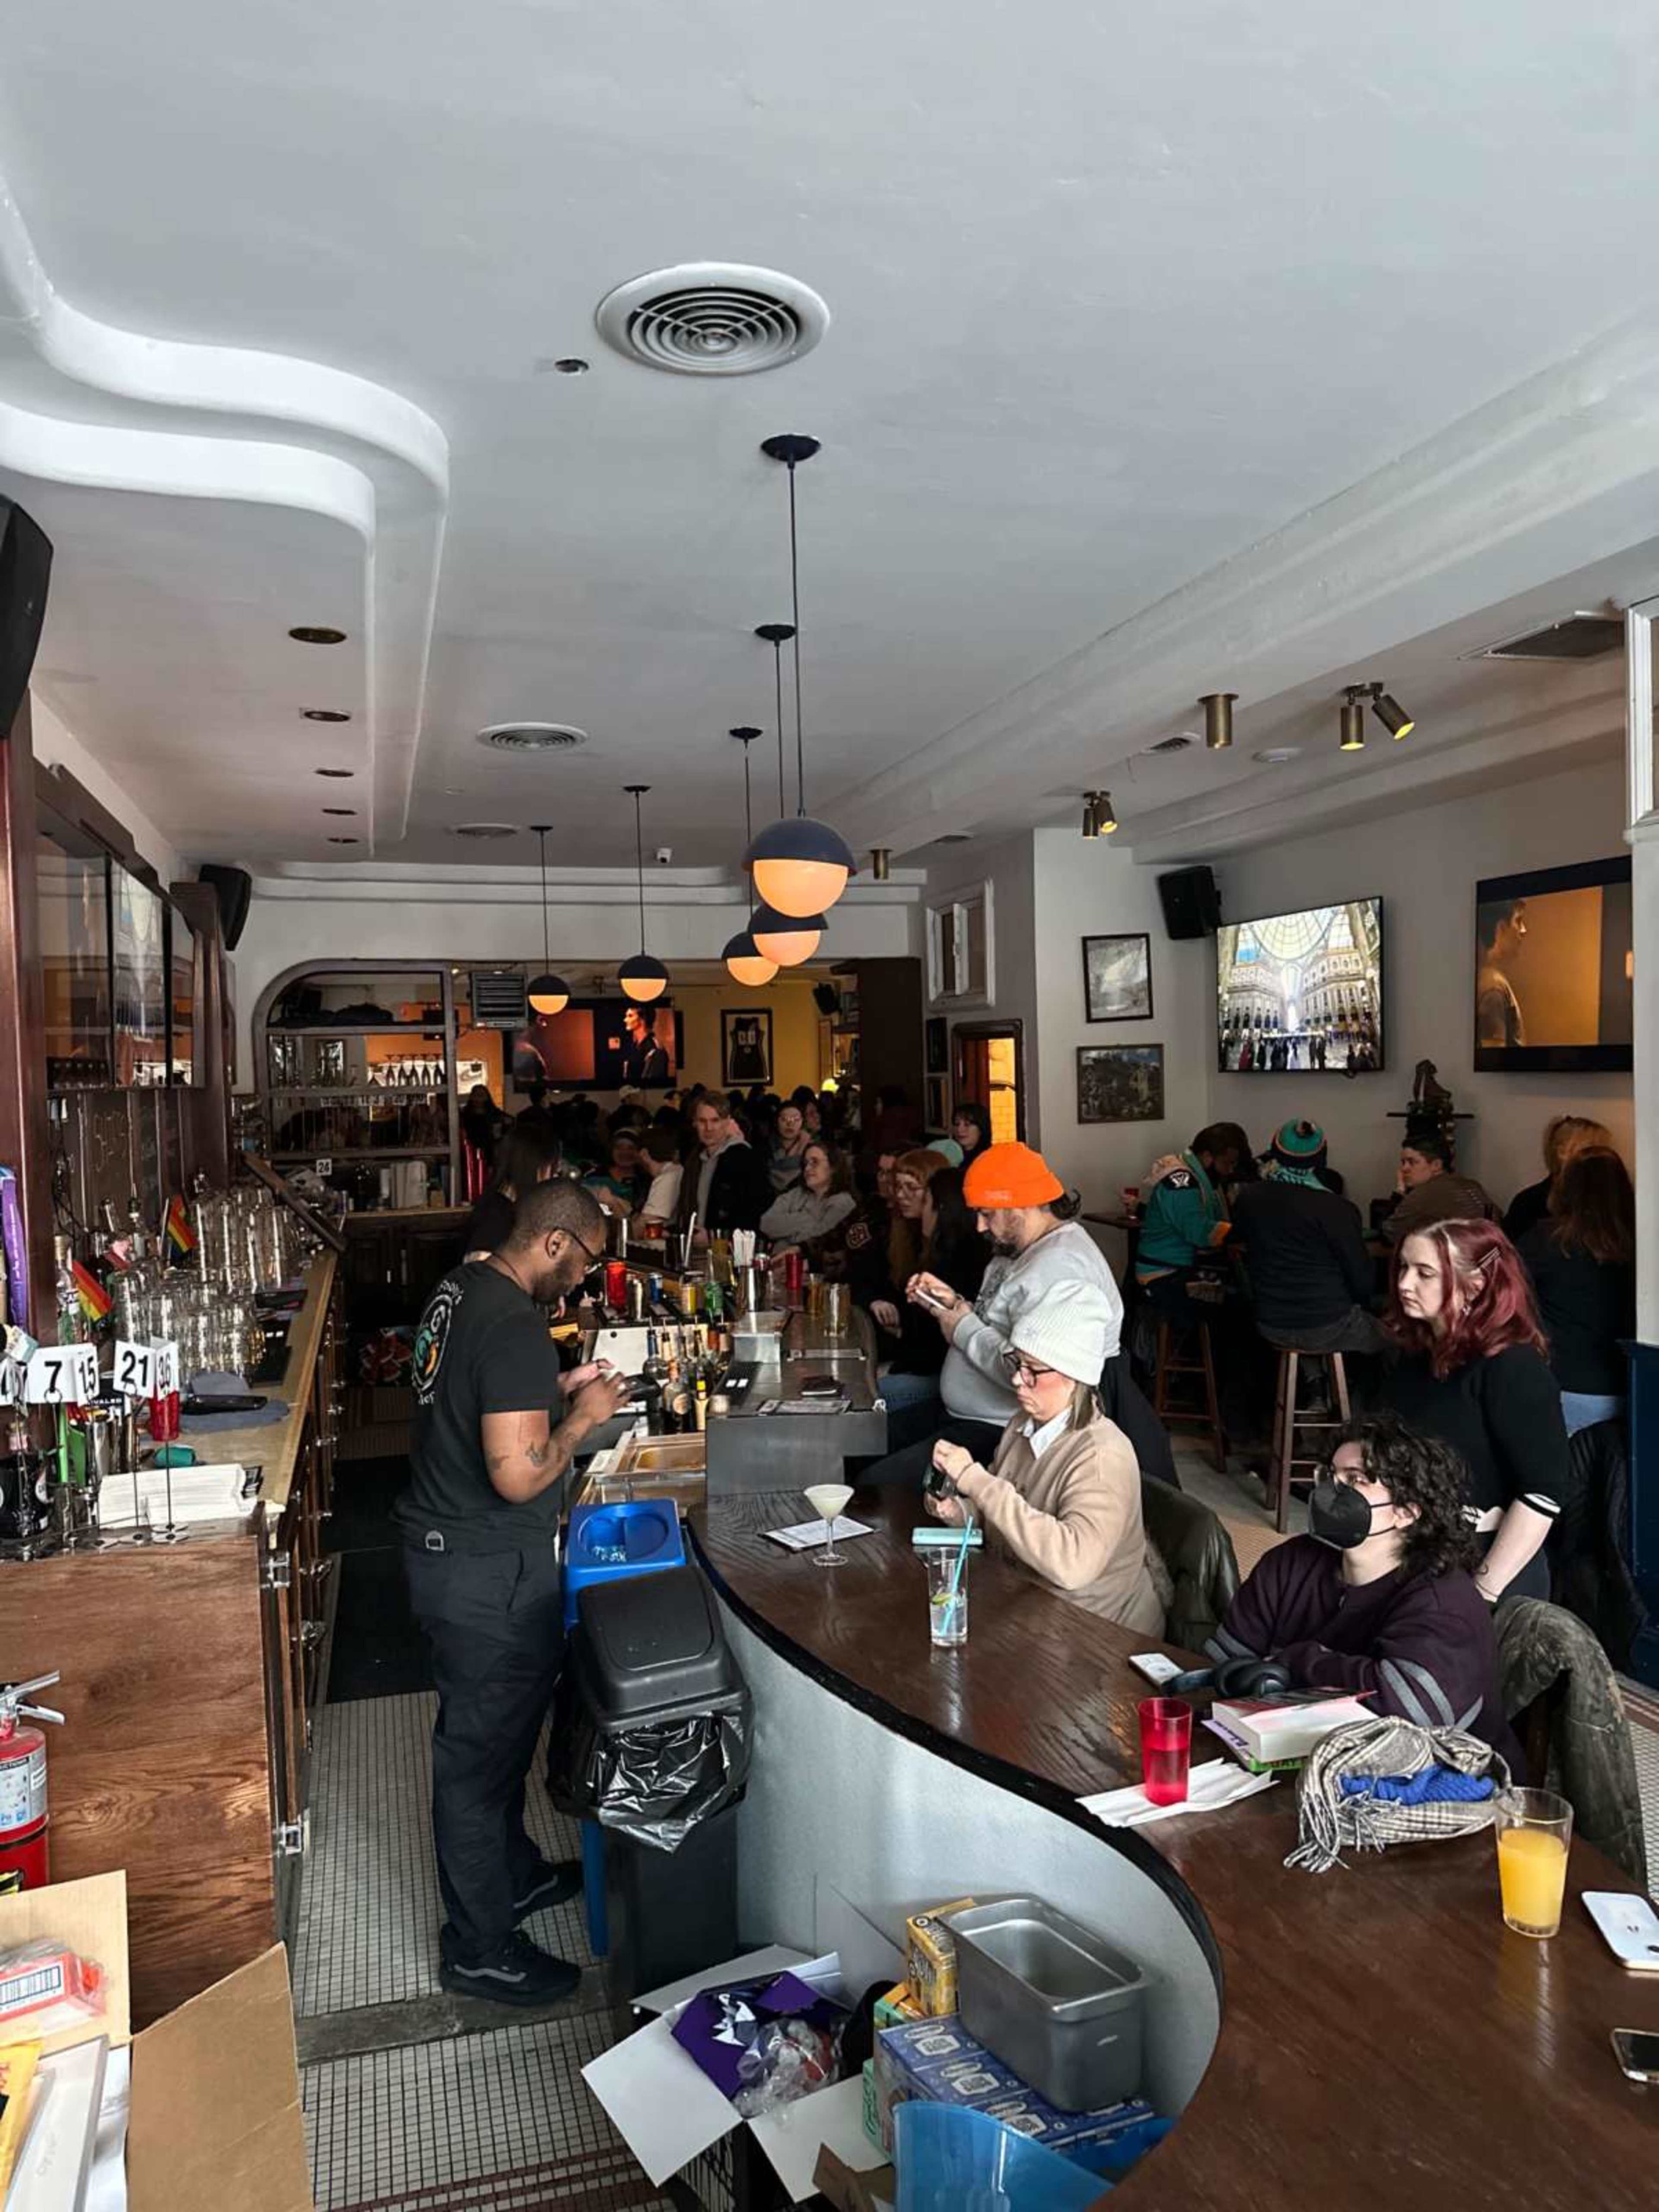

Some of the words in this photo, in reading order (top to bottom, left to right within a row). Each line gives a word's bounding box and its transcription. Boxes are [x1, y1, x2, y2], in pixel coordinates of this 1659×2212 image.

[44, 1361, 62, 1392] 7
[79, 1356, 95, 1394] 15
[121, 1350, 149, 1388] 21
[158, 1352, 171, 1389] 36
